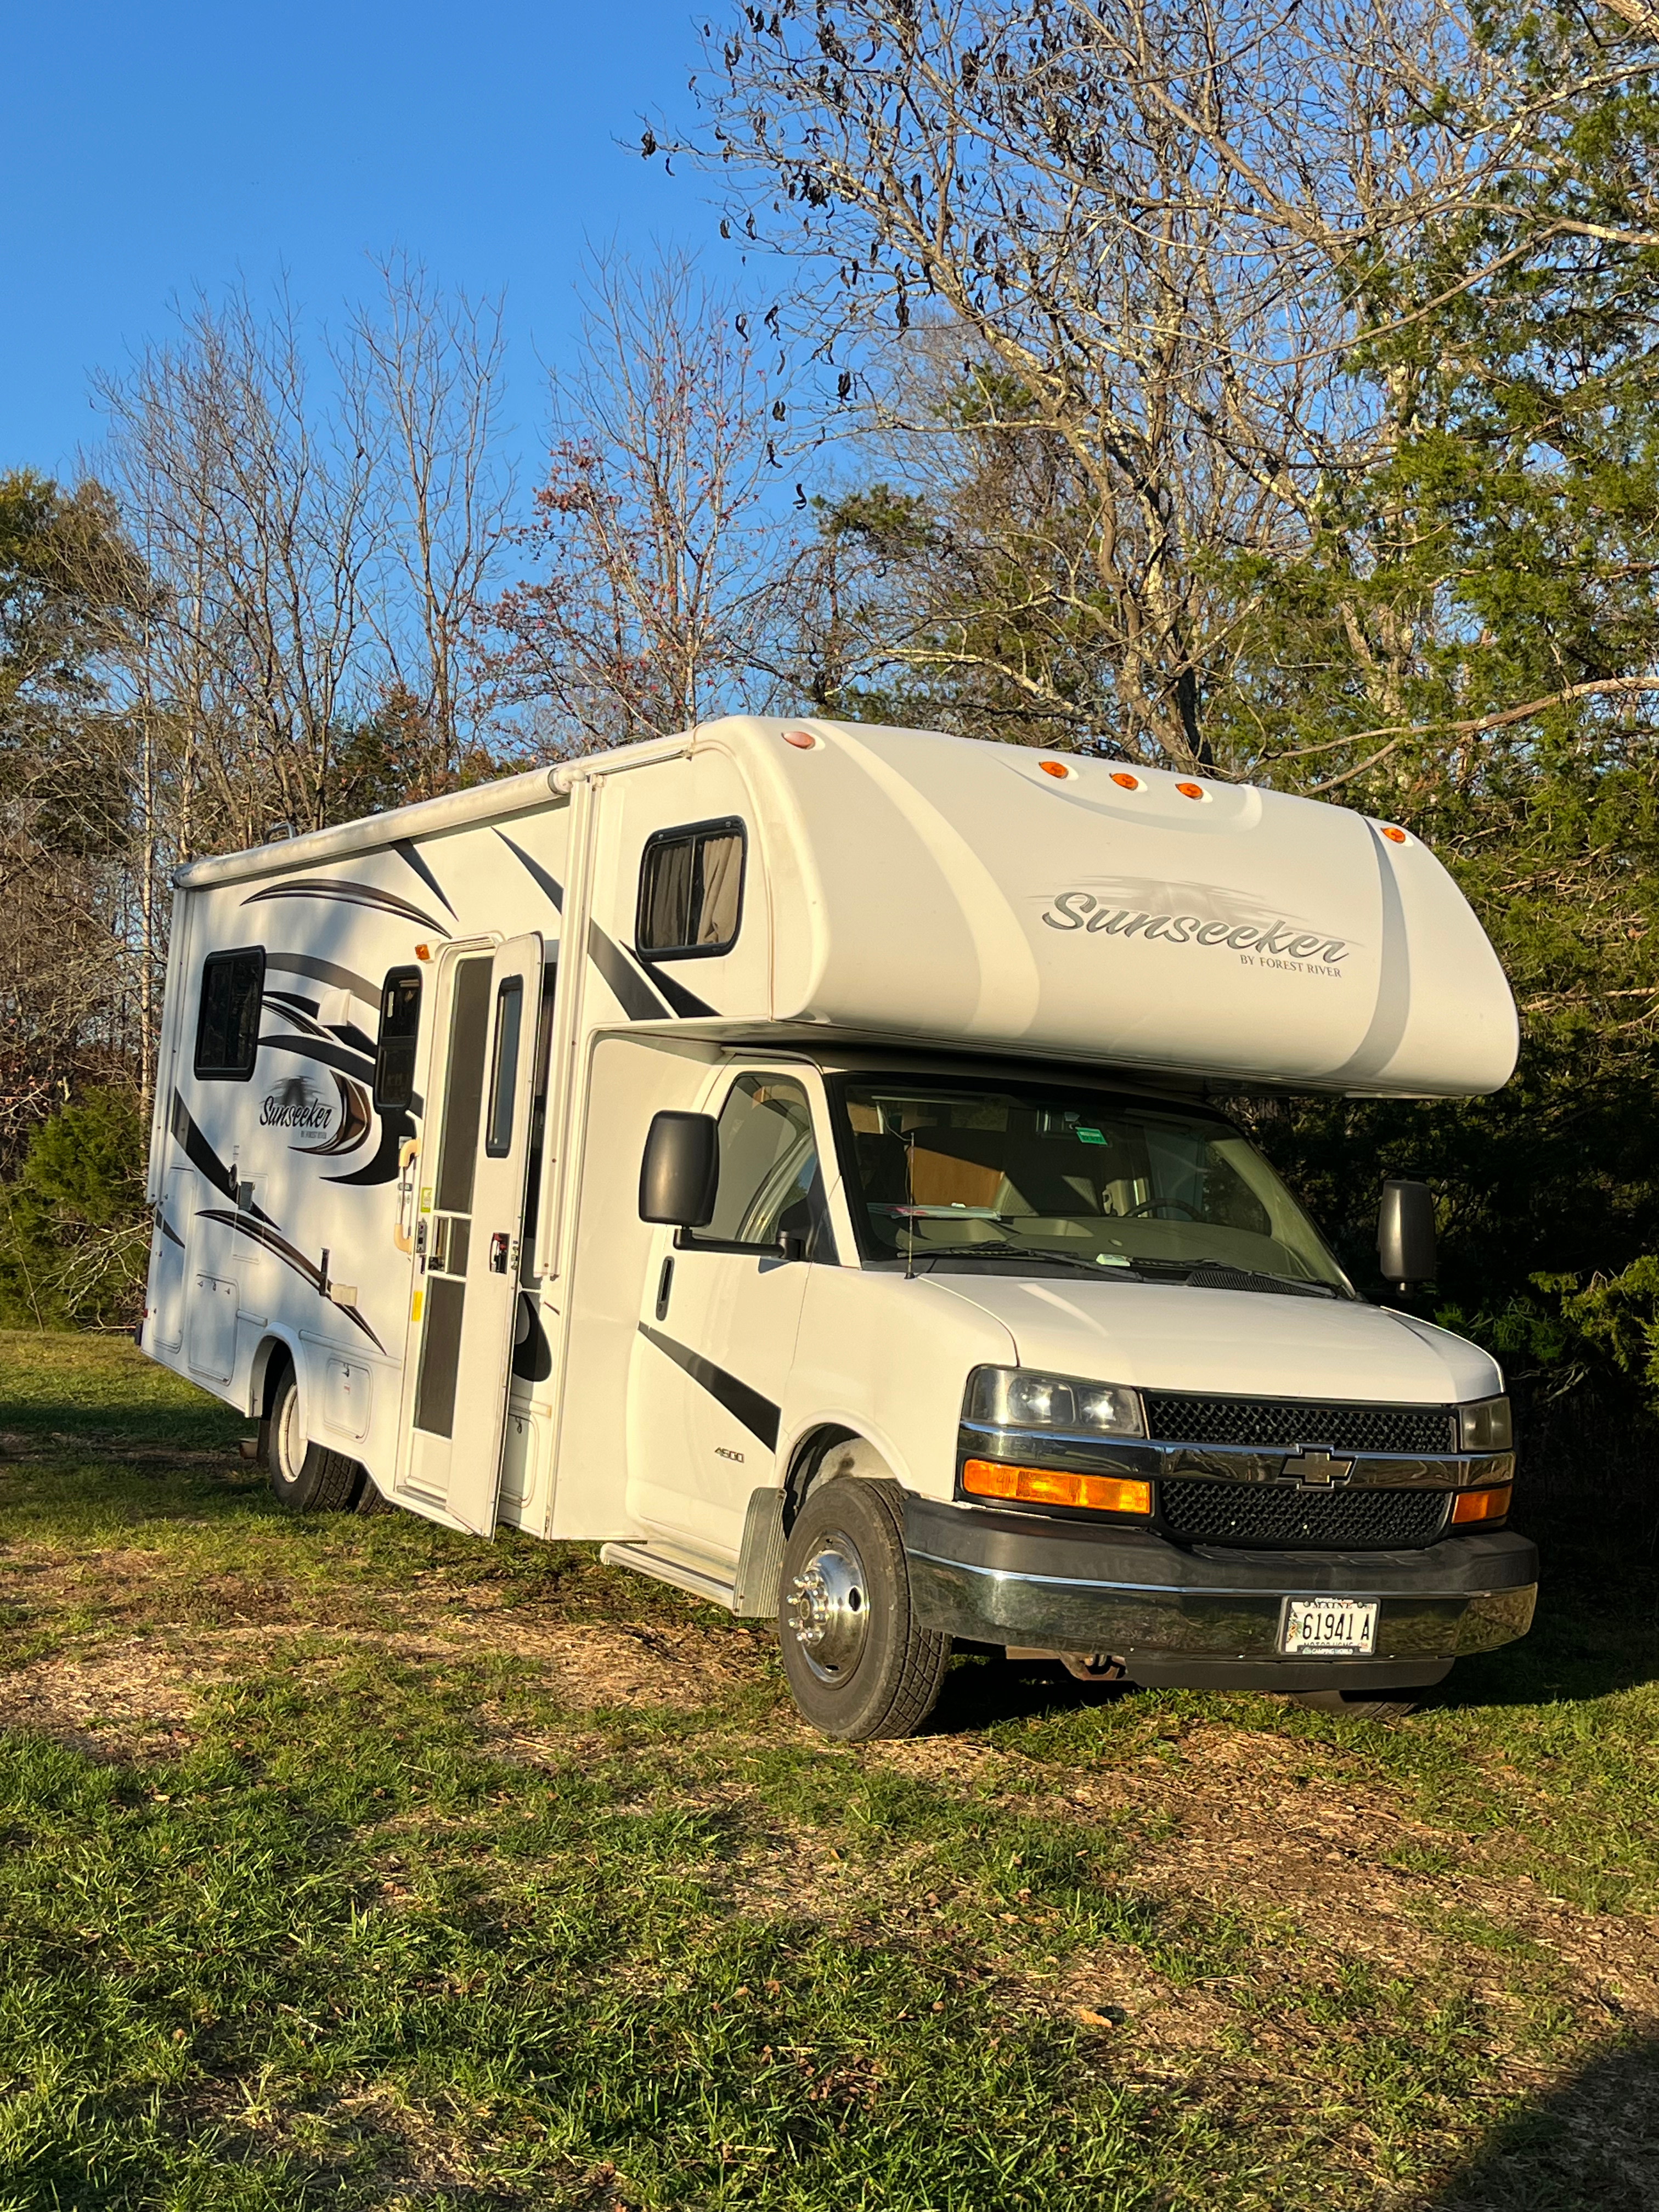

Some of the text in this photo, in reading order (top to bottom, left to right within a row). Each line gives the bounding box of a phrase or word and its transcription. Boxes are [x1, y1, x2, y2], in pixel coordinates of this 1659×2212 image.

[1042, 891, 1349, 963] Sunseeker
[1240, 954, 1342, 978] BY FOREST RIVER
[259, 1096, 332, 1129] Sunseeker
[1302, 1613, 1370, 1640] 61941 A
